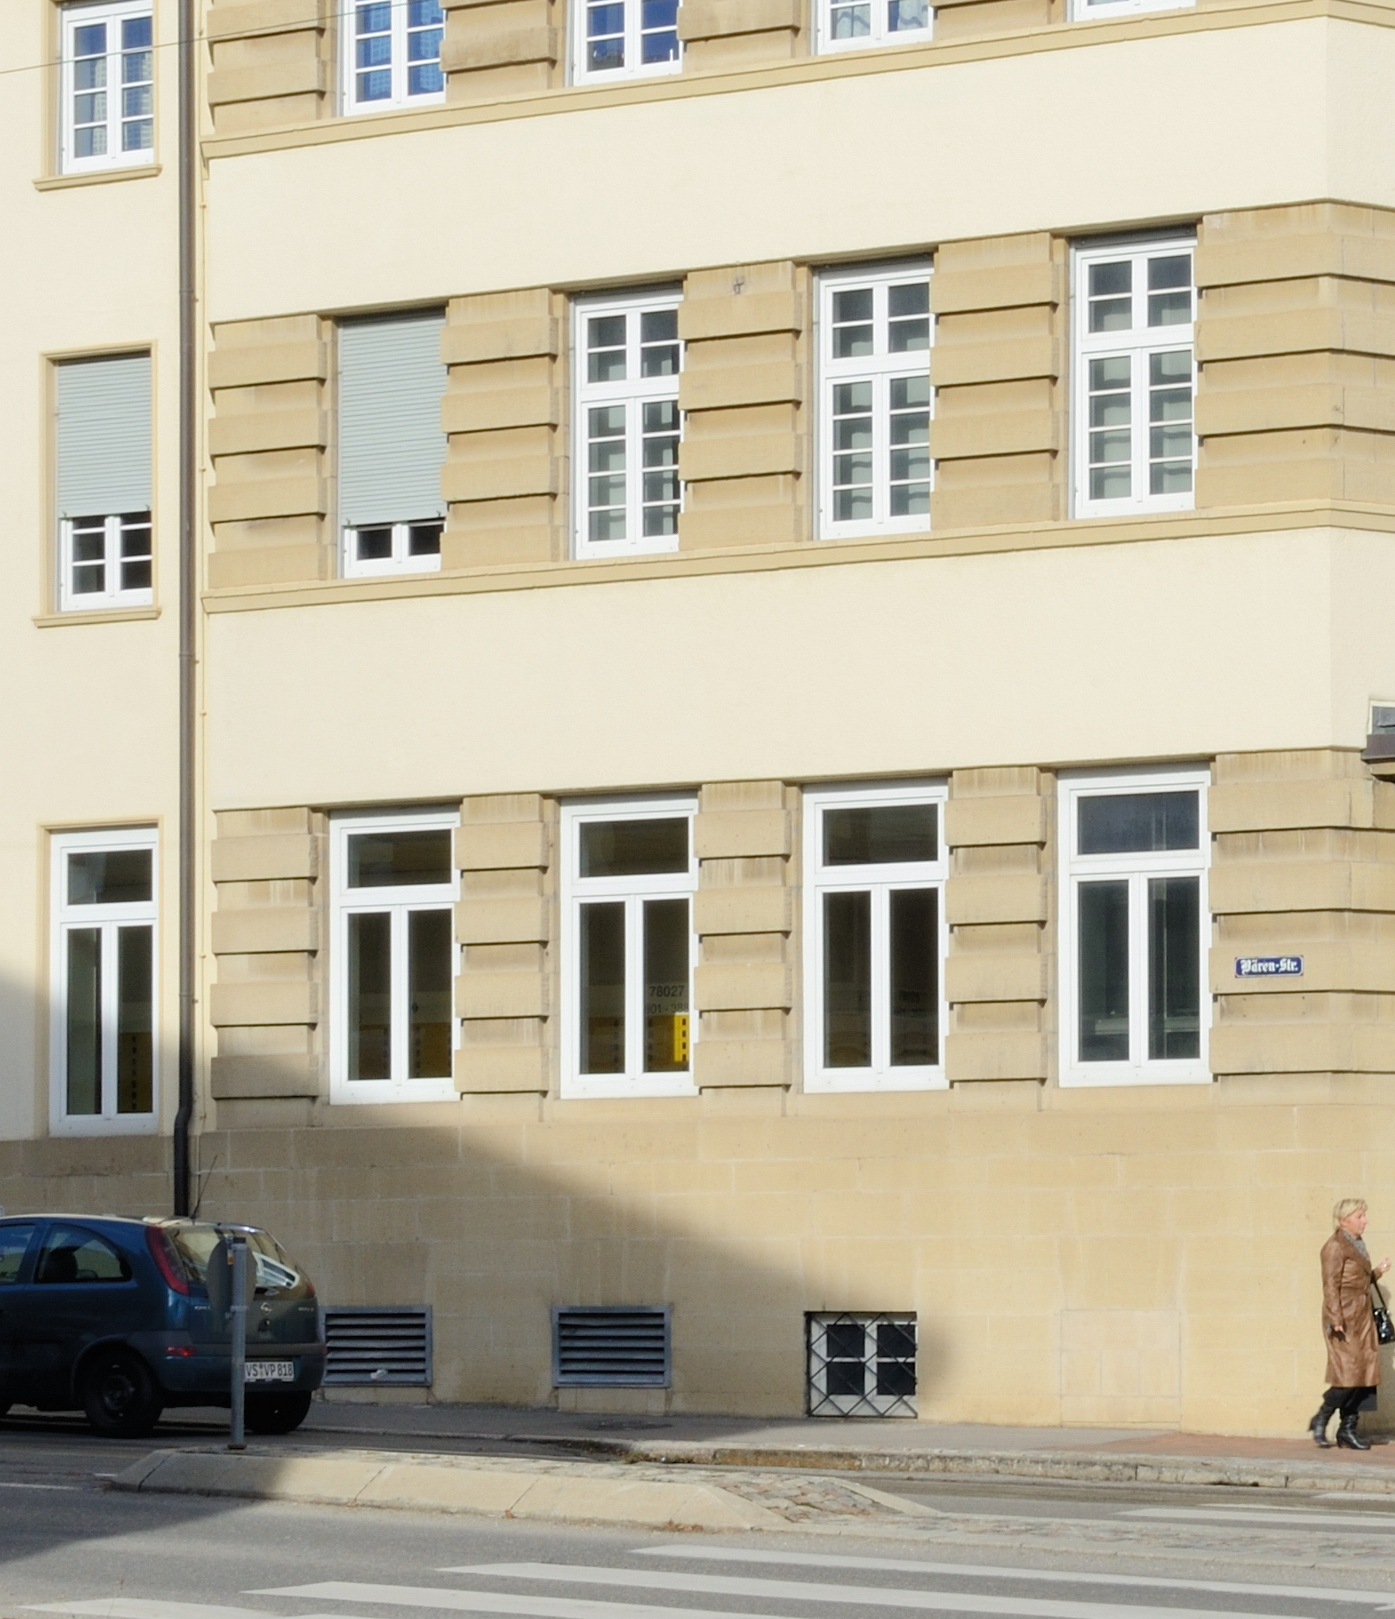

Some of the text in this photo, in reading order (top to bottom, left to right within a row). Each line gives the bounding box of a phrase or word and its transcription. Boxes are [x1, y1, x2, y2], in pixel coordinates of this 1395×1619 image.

[1240, 959, 1299, 976] Bären-Str.
[245, 1363, 293, 1377] VS VP 818
